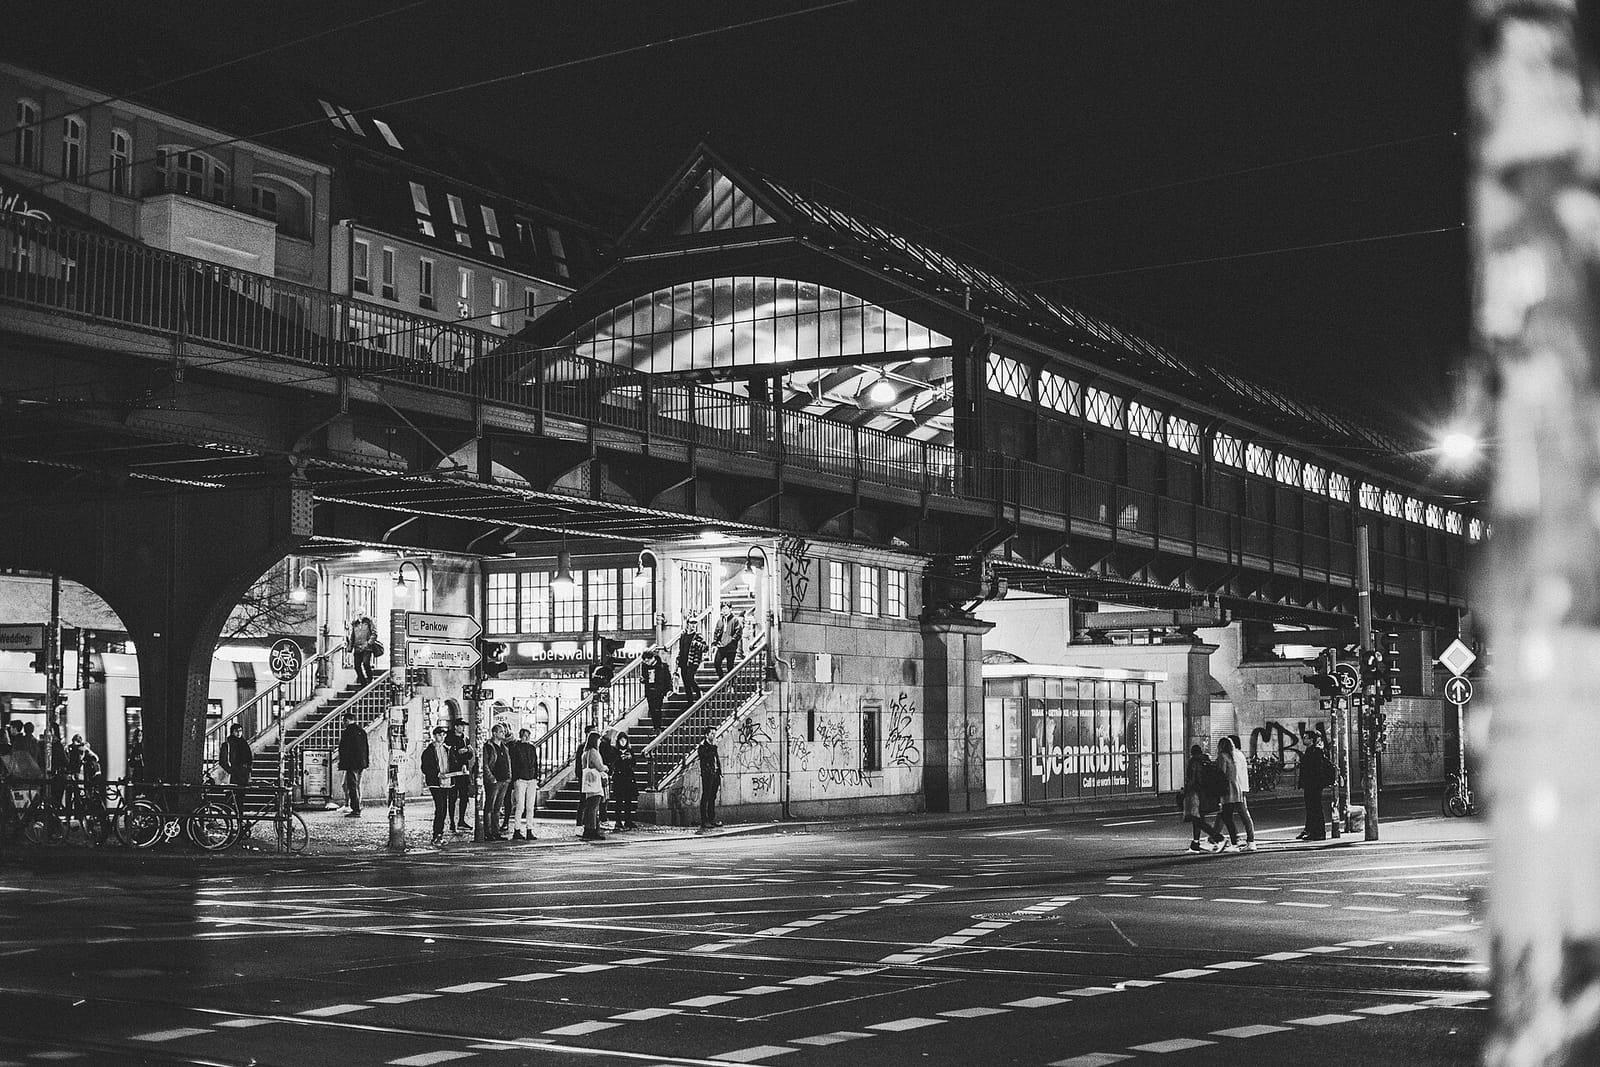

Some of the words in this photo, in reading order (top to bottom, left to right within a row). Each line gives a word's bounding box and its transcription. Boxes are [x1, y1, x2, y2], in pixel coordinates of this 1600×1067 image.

[420, 620, 449, 632] Pankow
[531, 643, 594, 661] Eberswald
[1031, 736, 1129, 784] Lycamobile
